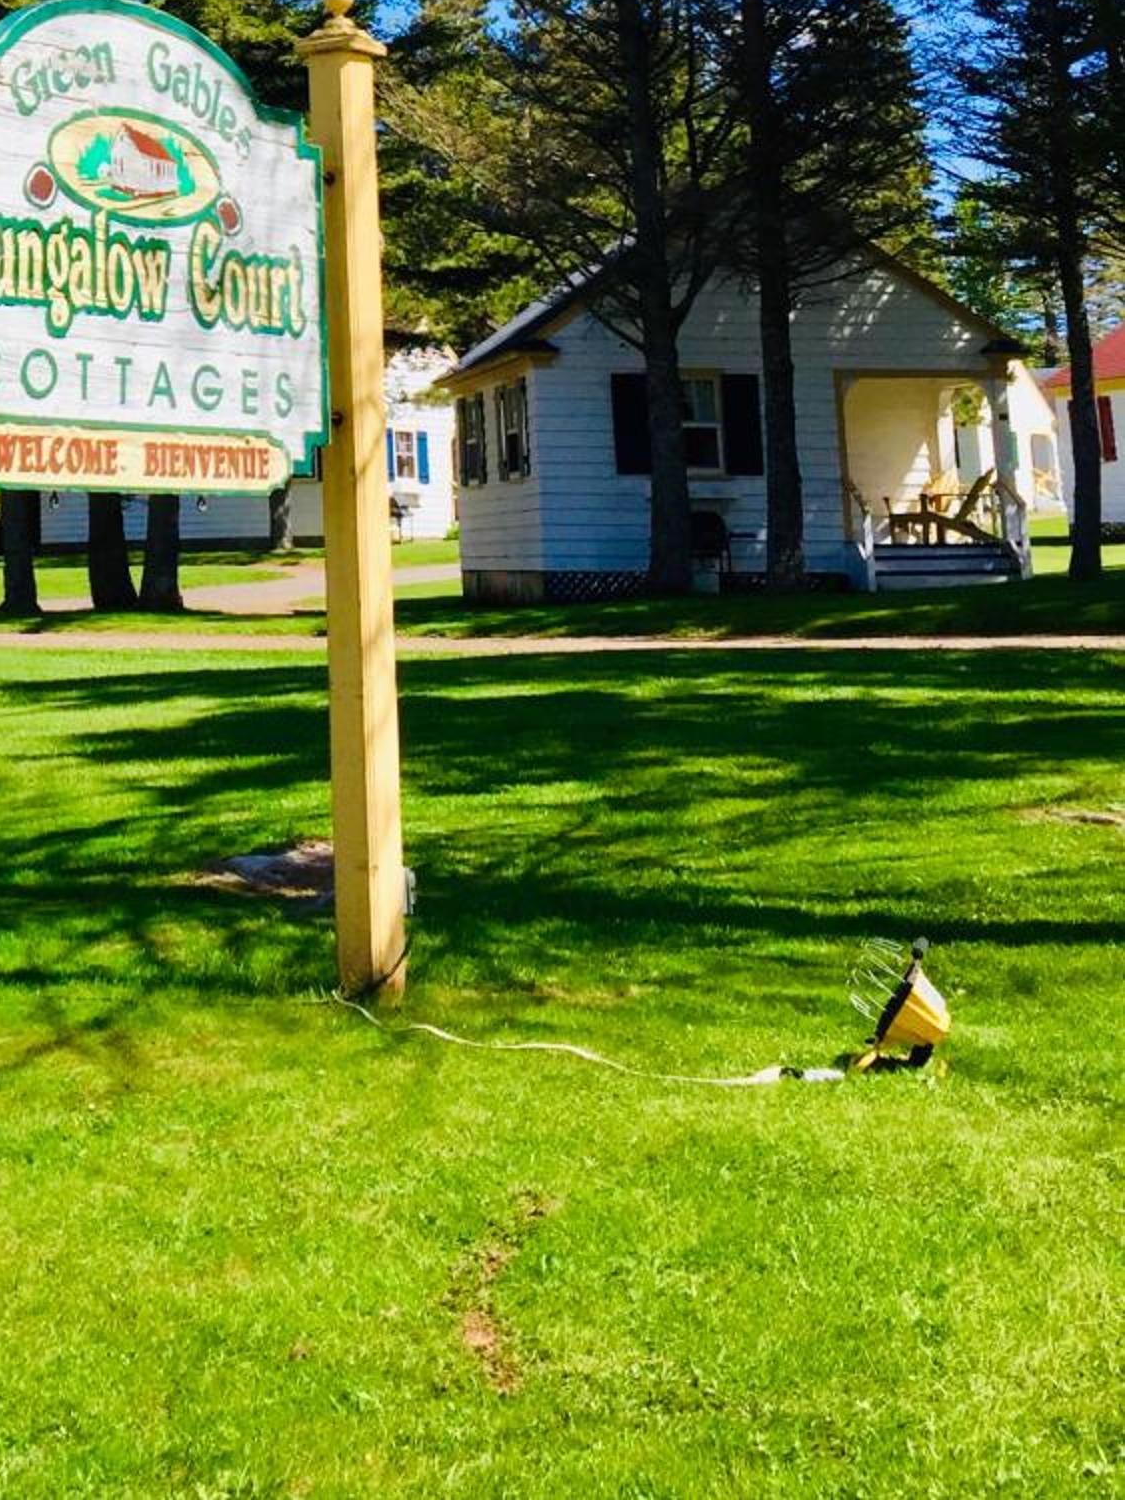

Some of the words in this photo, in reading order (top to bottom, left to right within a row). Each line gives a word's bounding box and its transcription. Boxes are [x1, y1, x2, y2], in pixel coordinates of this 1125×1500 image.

[10, 41, 117, 116] Green
[147, 41, 251, 158] Gables
[188, 218, 306, 338] Court
[143, 442, 271, 480] BIENVENUE
